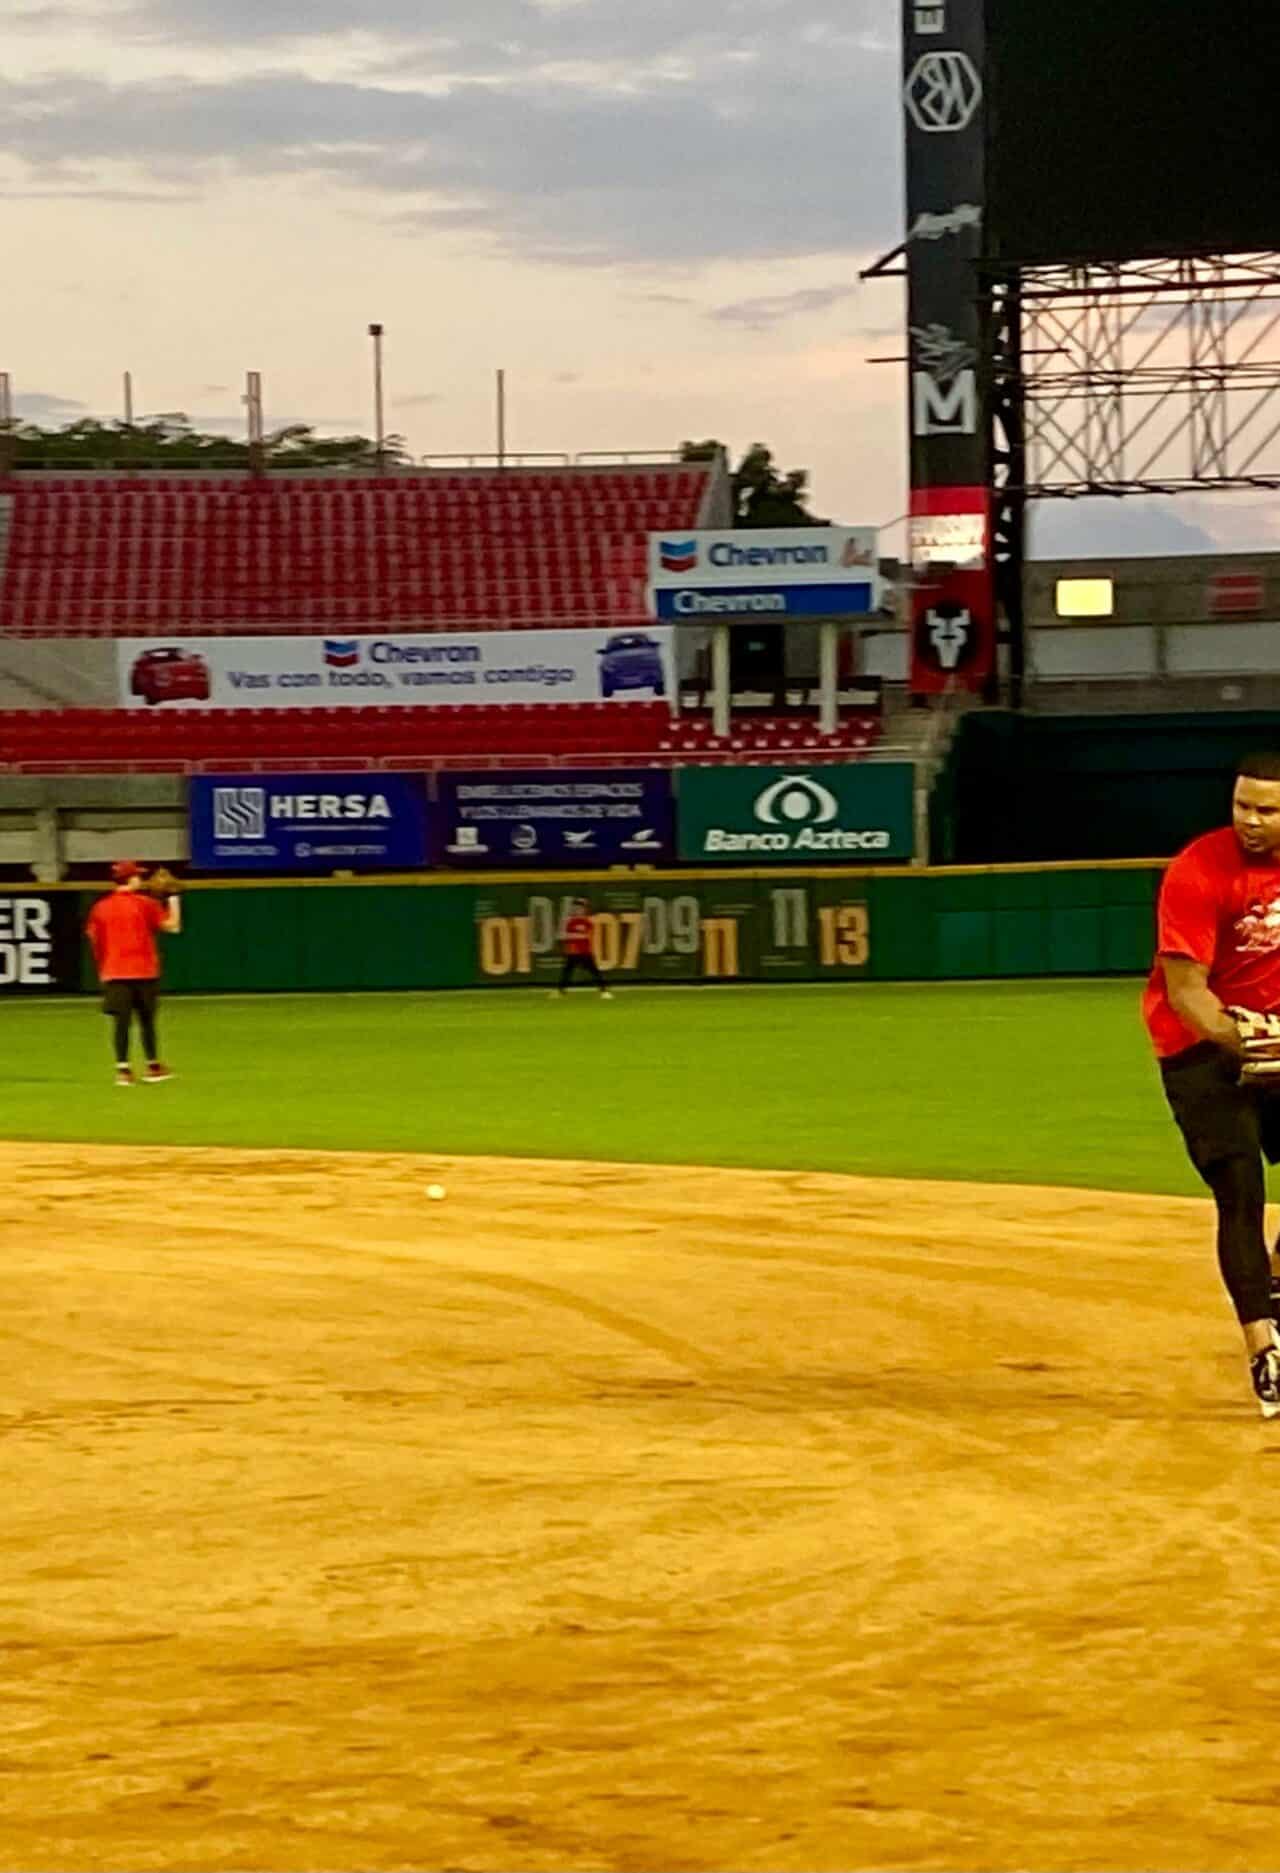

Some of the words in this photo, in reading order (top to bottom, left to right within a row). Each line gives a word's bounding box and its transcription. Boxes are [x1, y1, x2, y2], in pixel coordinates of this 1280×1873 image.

[708, 542, 828, 567] Chevron
[673, 590, 787, 613] Chevron
[368, 641, 481, 663] Chevron
[228, 671, 270, 688] Vas
[277, 672, 321, 688] con
[328, 668, 393, 689] todo,
[400, 669, 475, 686] vamos
[483, 664, 576, 686] contigo
[270, 794, 392, 819] HERSA
[704, 829, 790, 851] Banco
[793, 826, 891, 849] Azteca
[643, 896, 698, 954] 09
[818, 905, 869, 965] 13
[480, 916, 531, 974] 01
[593, 913, 642, 970] 07
